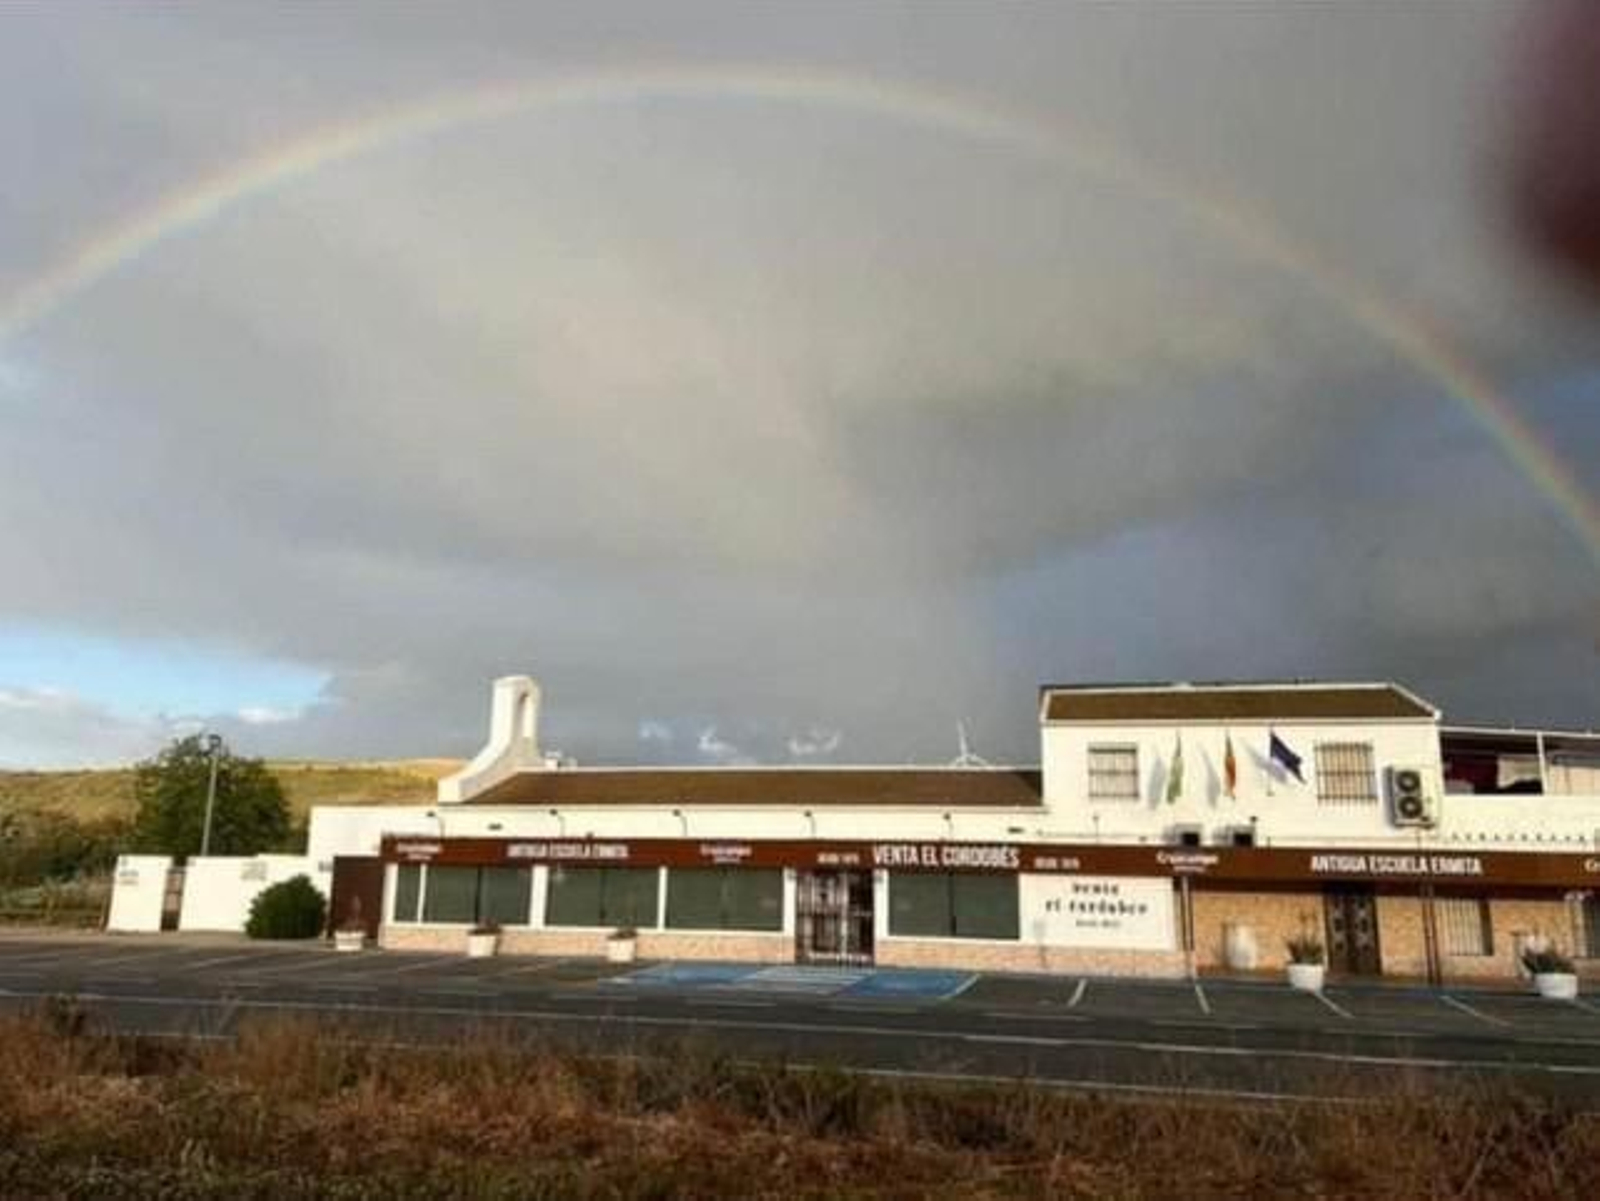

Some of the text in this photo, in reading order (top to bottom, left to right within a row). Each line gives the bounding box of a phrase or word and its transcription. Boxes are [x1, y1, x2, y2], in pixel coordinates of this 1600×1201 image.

[873, 845, 919, 866] VENTA
[921, 846, 938, 867] EL
[1310, 855, 1483, 876] ANTIGUA ESCUELA ERMITA
